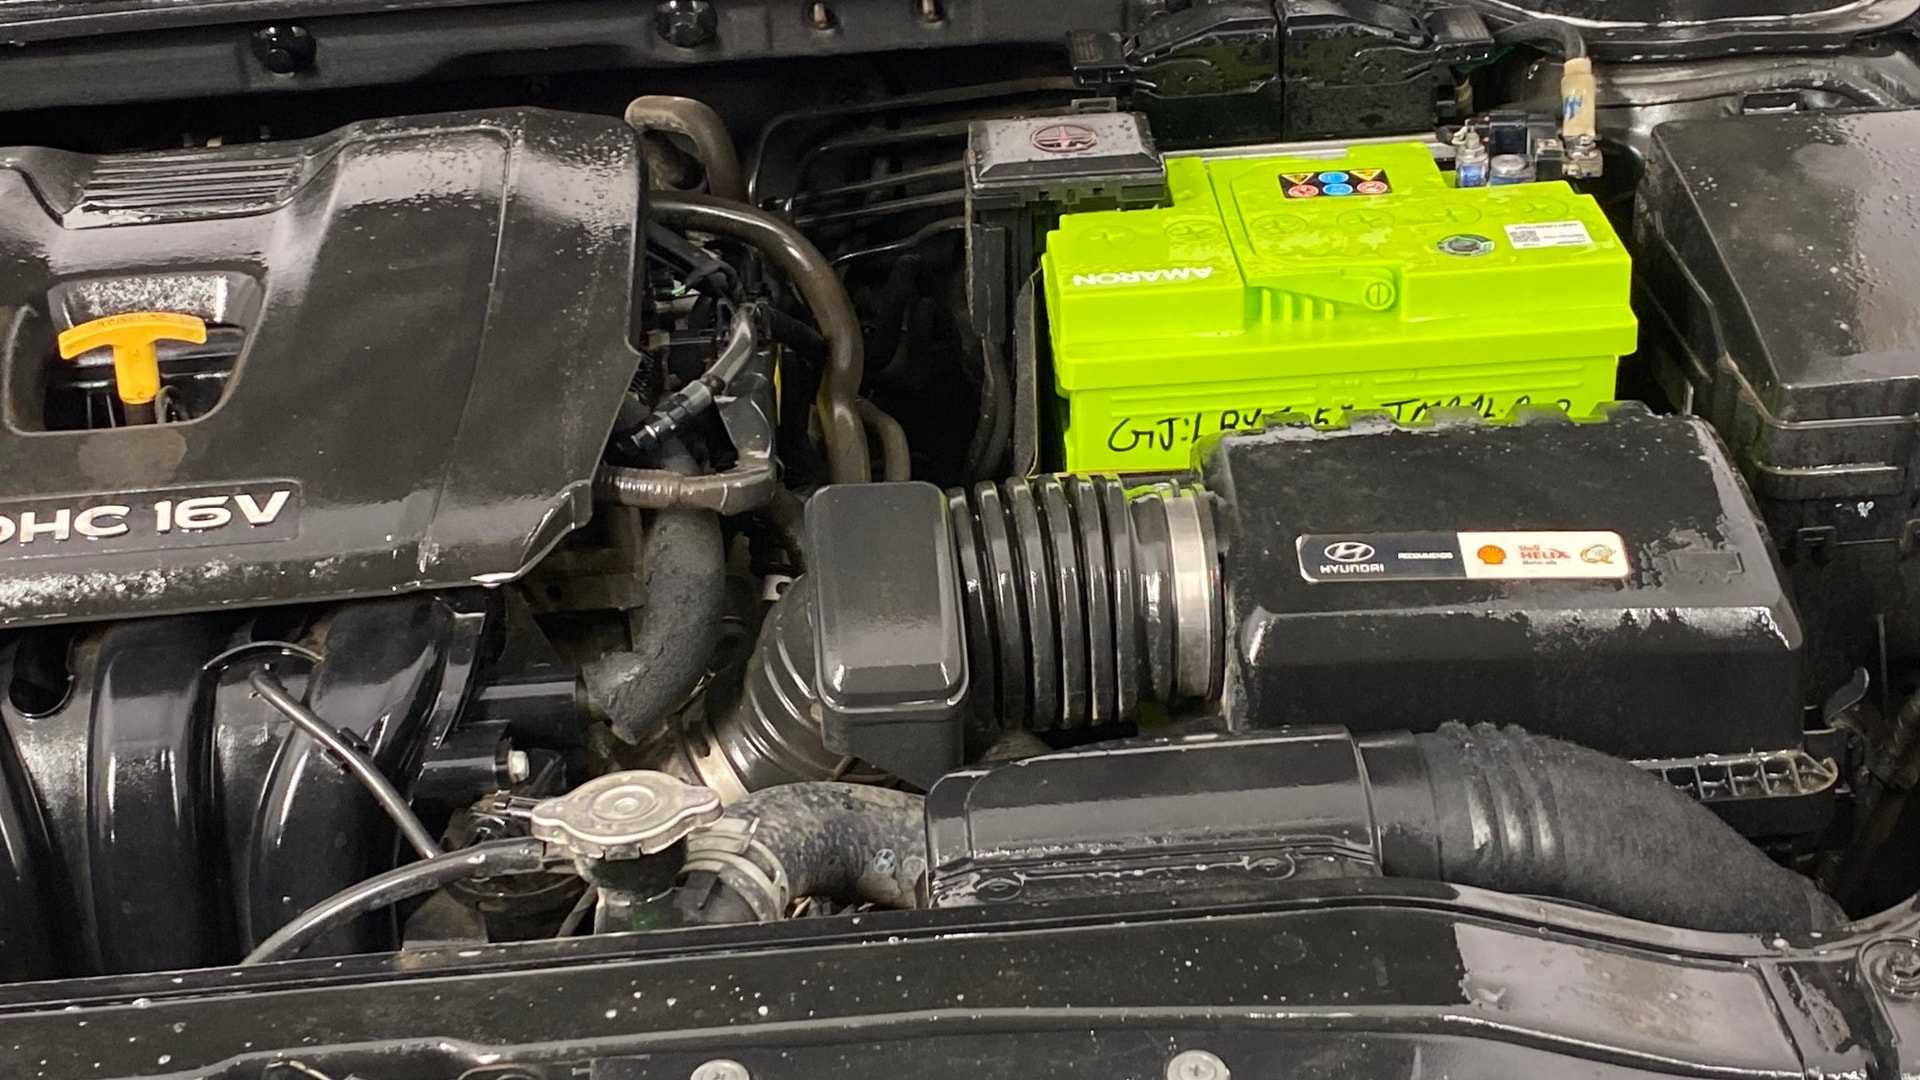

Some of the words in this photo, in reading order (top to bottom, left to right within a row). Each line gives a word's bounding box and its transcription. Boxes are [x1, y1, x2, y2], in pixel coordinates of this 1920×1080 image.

[1072, 266, 1214, 287] AMARON
[154, 491, 291, 533] 16V
[1520, 550, 1572, 559] HELIX
[1319, 564, 1385, 574] HYUNDAI
